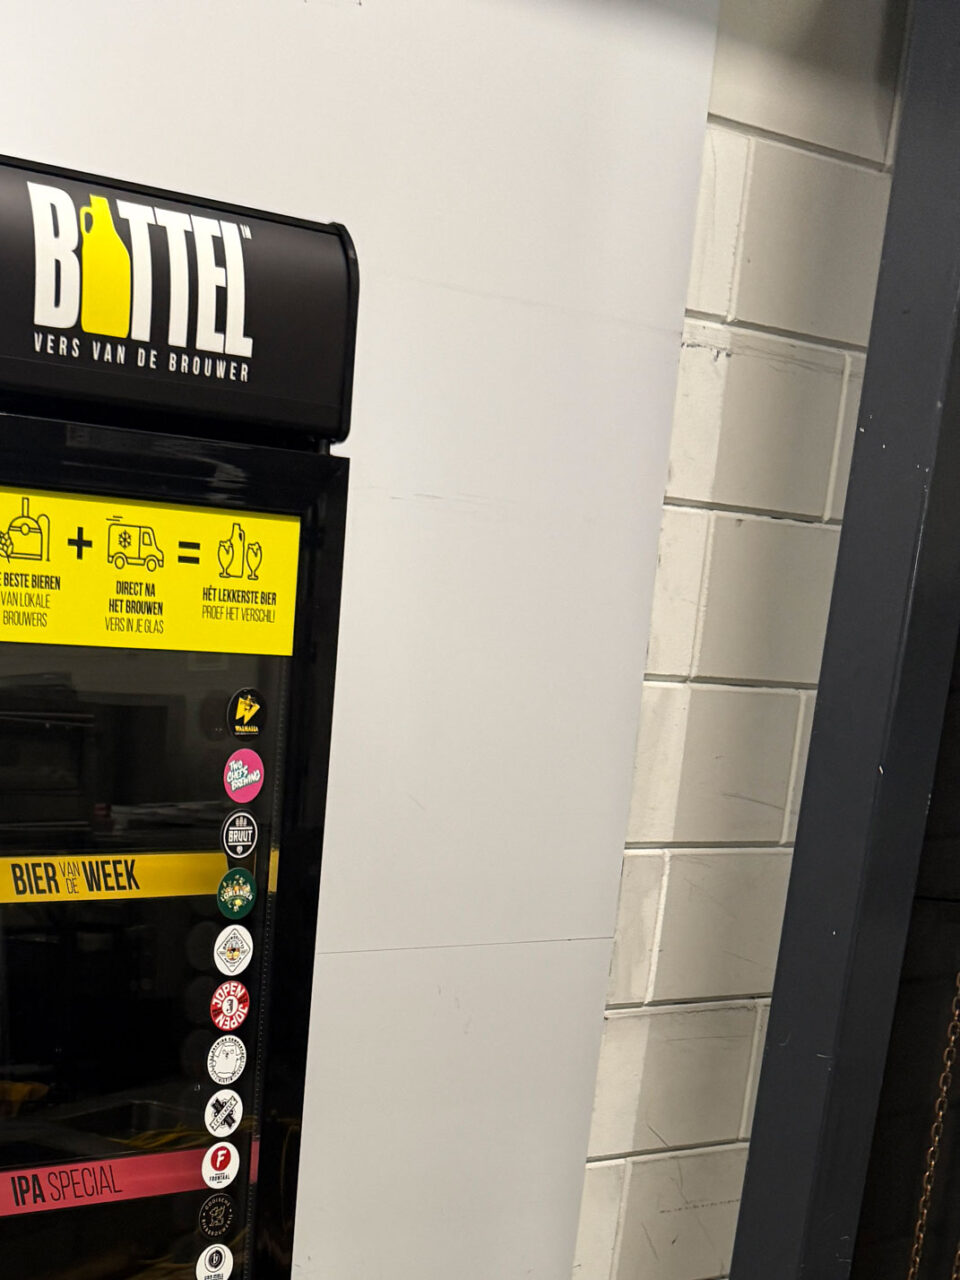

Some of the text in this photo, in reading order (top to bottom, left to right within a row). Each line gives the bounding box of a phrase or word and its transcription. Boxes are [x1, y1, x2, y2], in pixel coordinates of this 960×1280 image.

[34, 332, 248, 383] VERS VAN DE BROUWER
[4, 572, 29, 588] BESTE
[31, 574, 61, 591] BIEREN
[116, 580, 156, 597] DIRECT NA
[1, 590, 51, 609] VAN LOKALE
[202, 585, 277, 606] HÉT LEKKERSTE BIER
[109, 598, 163, 616] HET BROUWEN
[202, 605, 276, 623] PROEF HET VERSCHIL!
[3, 610, 47, 628] BROUWERS
[105, 616, 164, 634] VERS IN JE GLAS
[226, 765, 248, 783] CHEFS
[229, 759, 243, 773] TWO
[228, 830, 253, 842] BRUUT
[11, 859, 140, 895] BIER VAN WEEK
[65, 878, 79, 895] DE
[212, 982, 246, 1008] JOPEN
[214, 1003, 248, 1029] JOPEN
[216, 1149, 227, 1168] F
[10, 1164, 123, 1207] IPA SPECIAL
